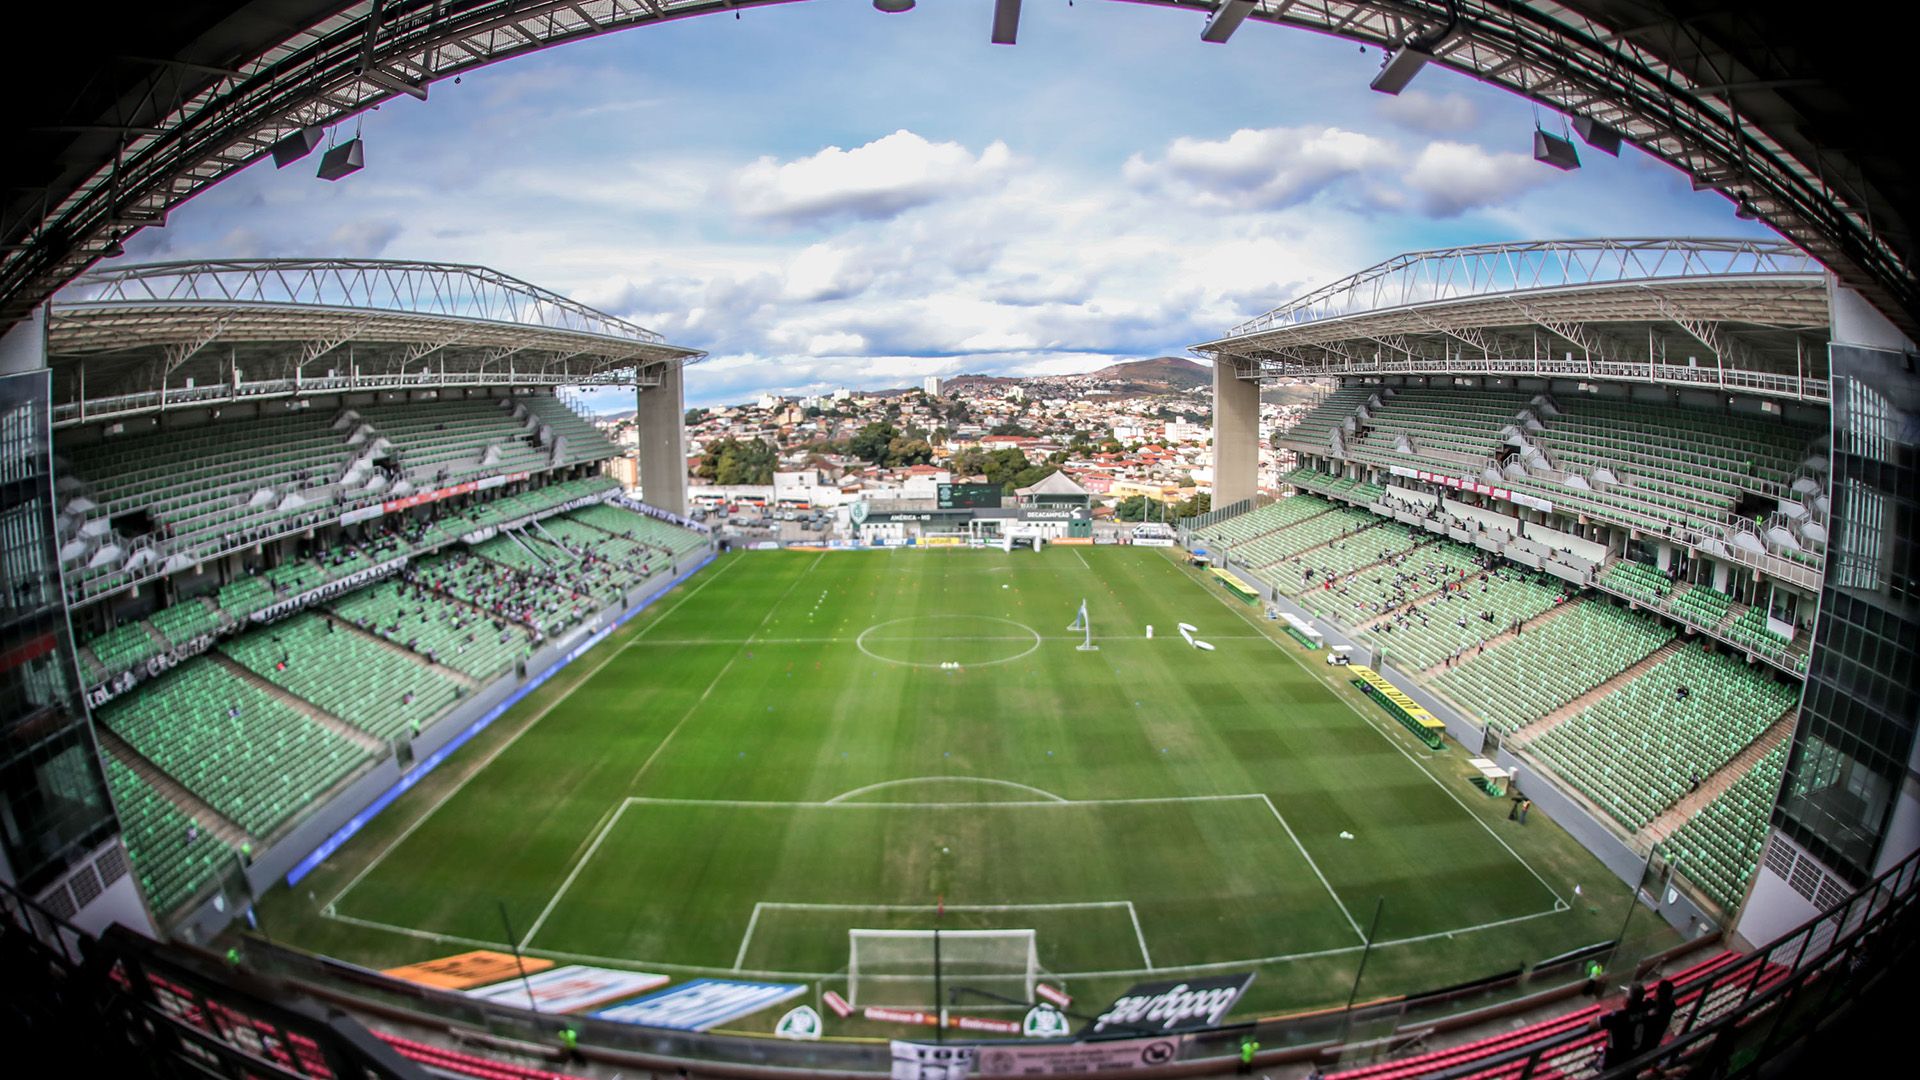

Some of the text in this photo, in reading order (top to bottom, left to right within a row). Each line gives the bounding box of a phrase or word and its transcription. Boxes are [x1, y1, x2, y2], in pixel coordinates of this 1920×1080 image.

[890, 513, 917, 521] AMÉRICA
[1027, 510, 1070, 518] DECACAMPEÃO
[264, 563, 399, 623] UNIFORMIZADA
